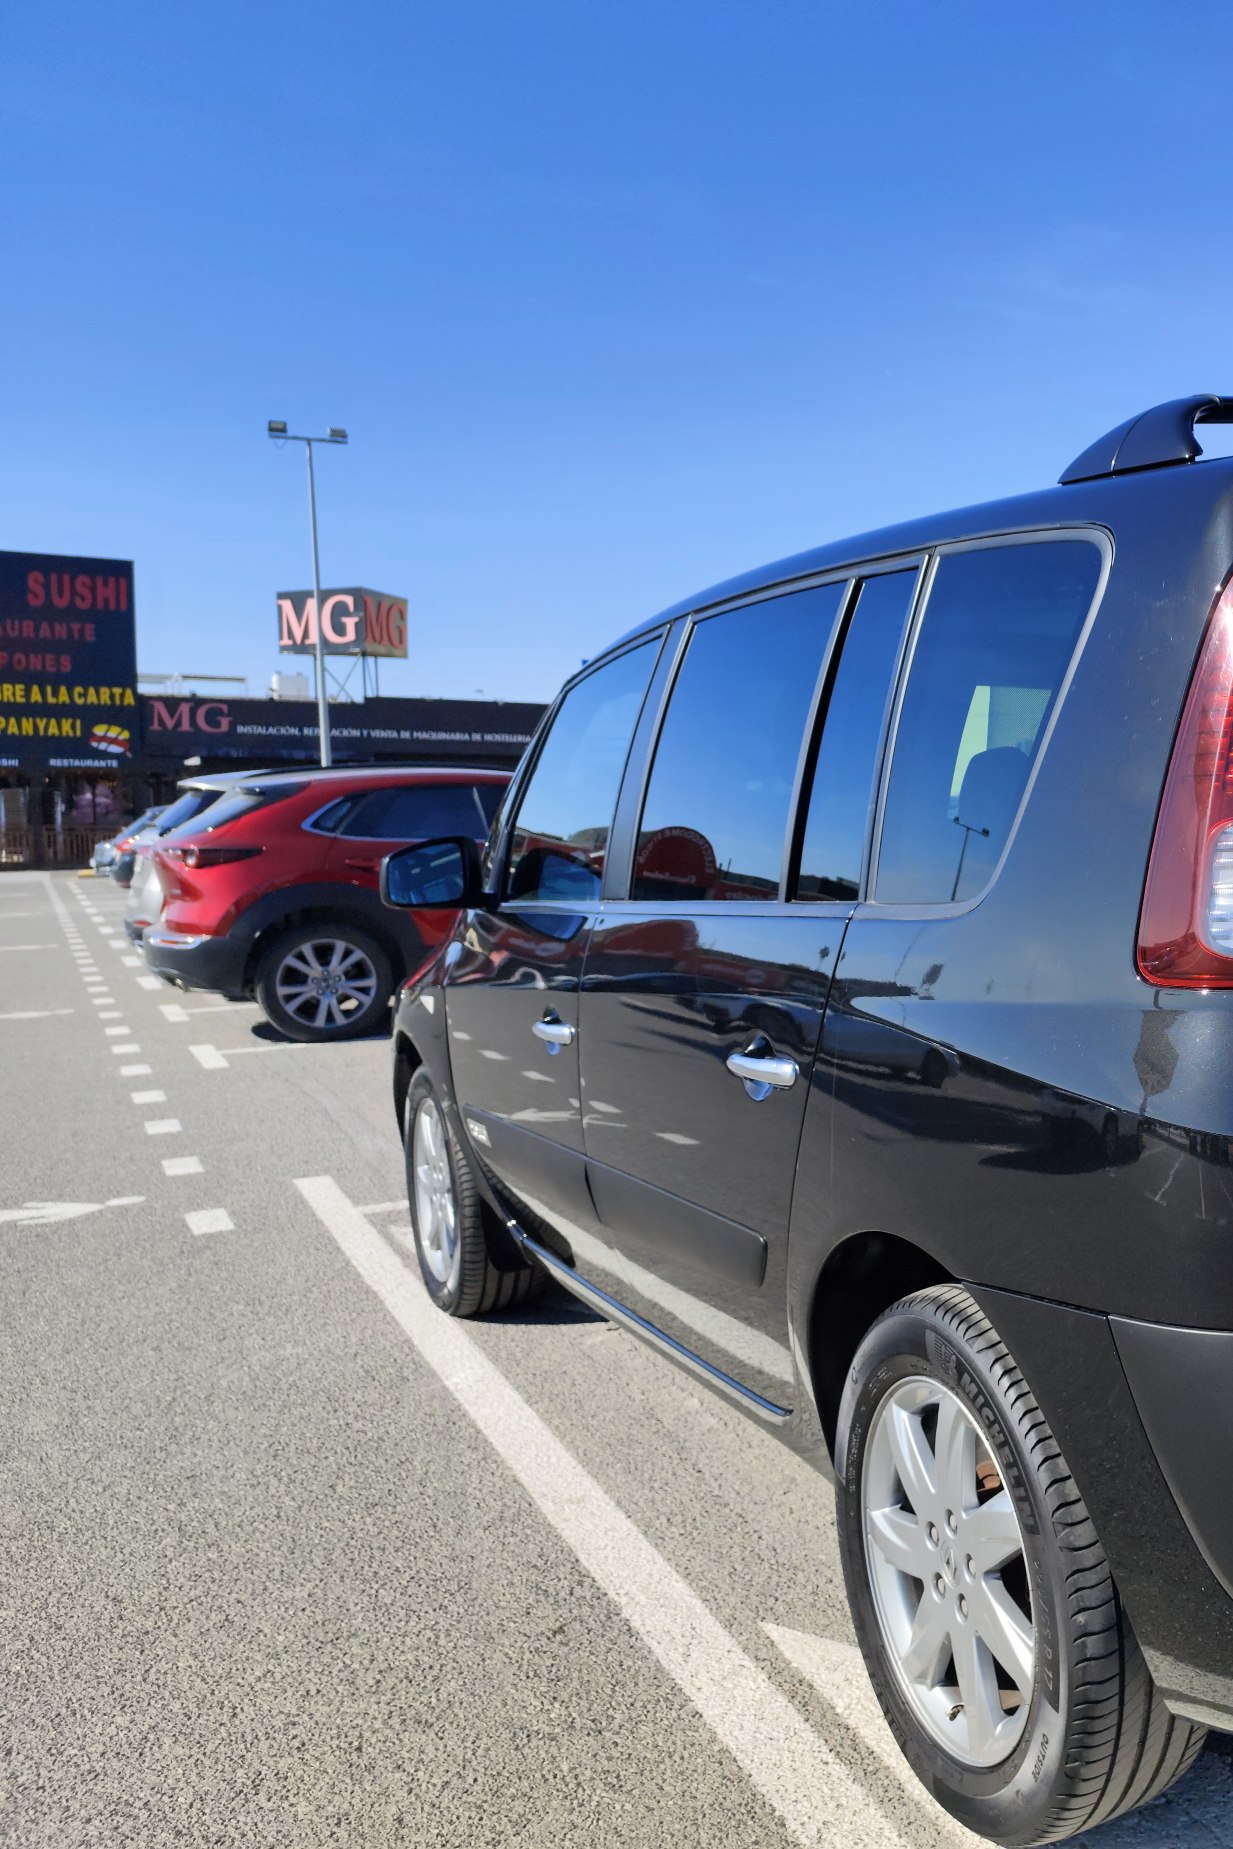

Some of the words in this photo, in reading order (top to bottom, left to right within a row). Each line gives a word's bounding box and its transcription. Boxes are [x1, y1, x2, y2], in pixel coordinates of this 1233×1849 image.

[27, 571, 128, 612] SUSHI
[277, 594, 359, 647] MG
[363, 596, 406, 649] MG
[30, 684, 43, 704] A
[46, 685, 70, 704] LA
[73, 686, 136, 706] CARTA
[150, 701, 233, 734] MG
[303, 726, 361, 738] REPACIÓN
[361, 728, 368, 738] Y
[369, 729, 398, 739] VENTA
[401, 730, 411, 740] DE
[413, 730, 469, 742] MAQUINARIA
[471, 732, 483, 742] DE
[49, 758, 119, 768] RESTAURANTE
[960, 1371, 1041, 1535] MICHELIN
[1031, 1732, 1049, 1783] OUTSIDE
